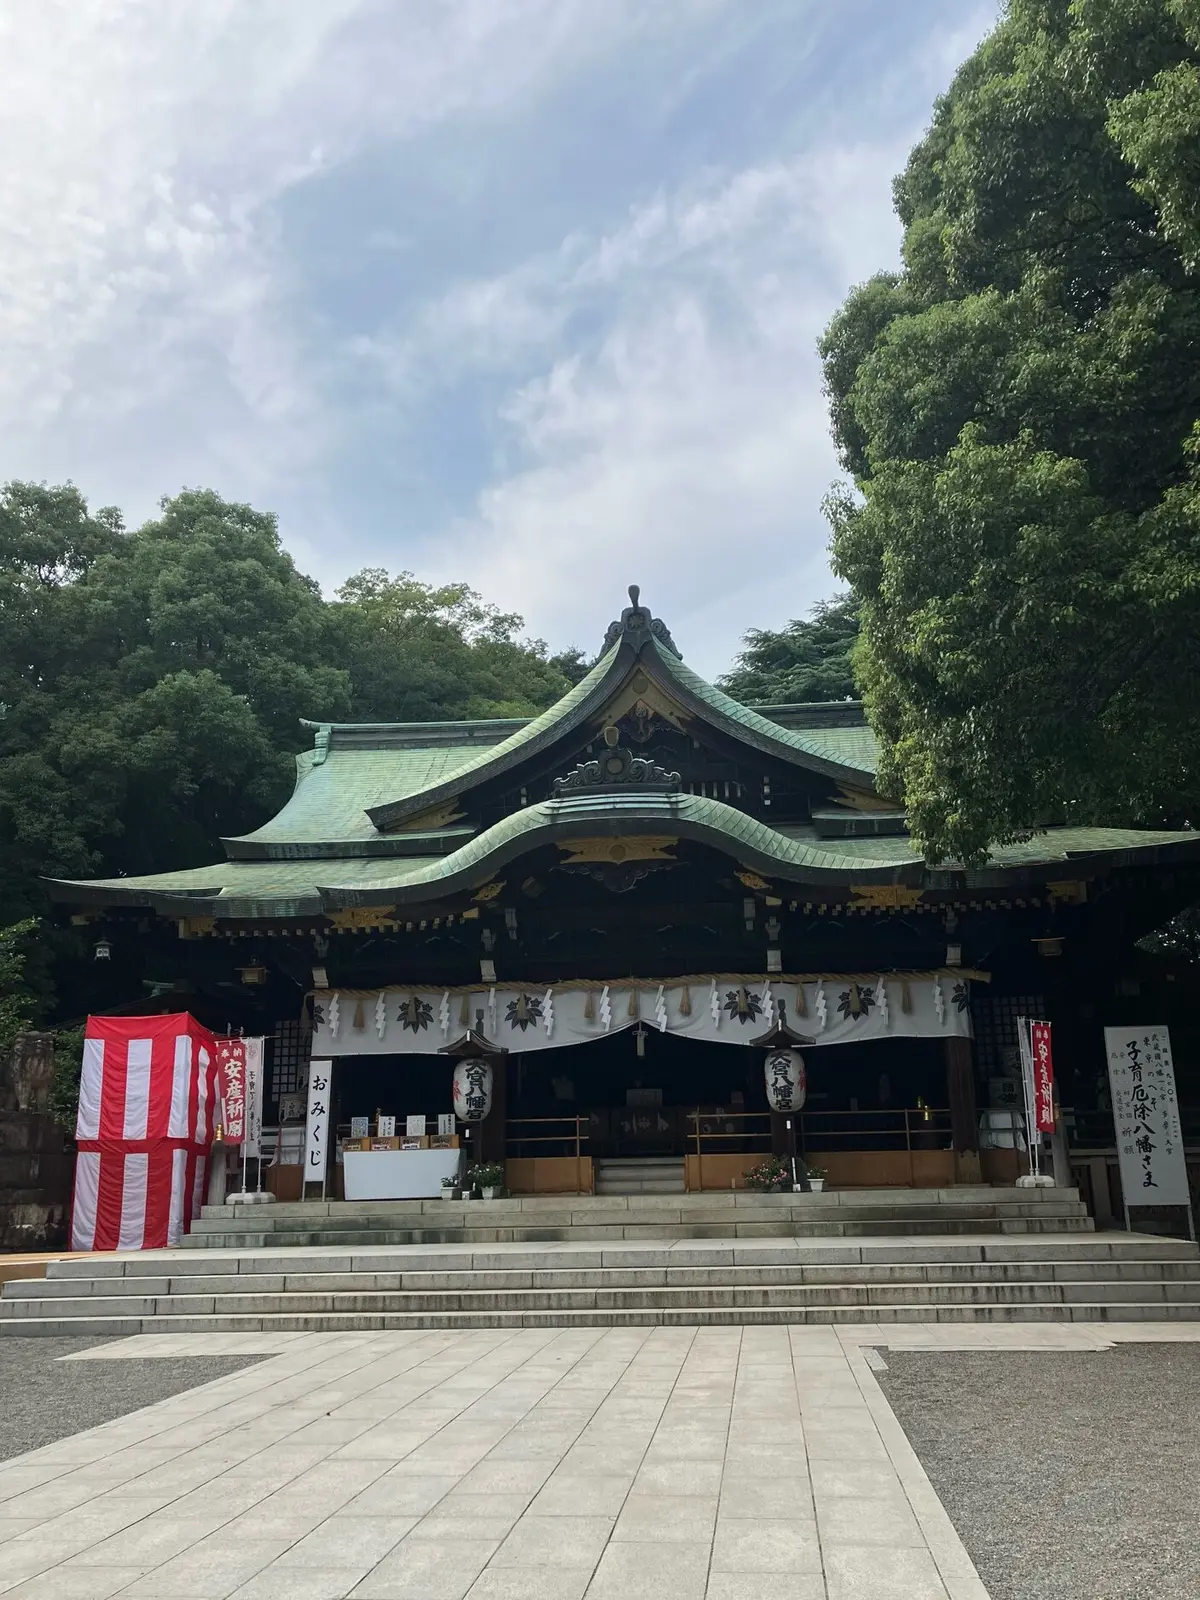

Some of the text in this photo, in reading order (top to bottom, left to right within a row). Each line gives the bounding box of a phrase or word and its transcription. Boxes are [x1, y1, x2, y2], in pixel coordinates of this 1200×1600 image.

[221, 1048, 242, 1058] 奉納
[465, 1061, 488, 1120] 大宮八幡宮
[770, 1052, 794, 1110] 大宮八幡宮
[1143, 1036, 1157, 1111] 東京のへそ
[224, 1059, 244, 1137] 安産祈願
[310, 1075, 328, 1166] おみくじ
[1126, 1041, 1159, 1188] 子育厄除八幡さま
